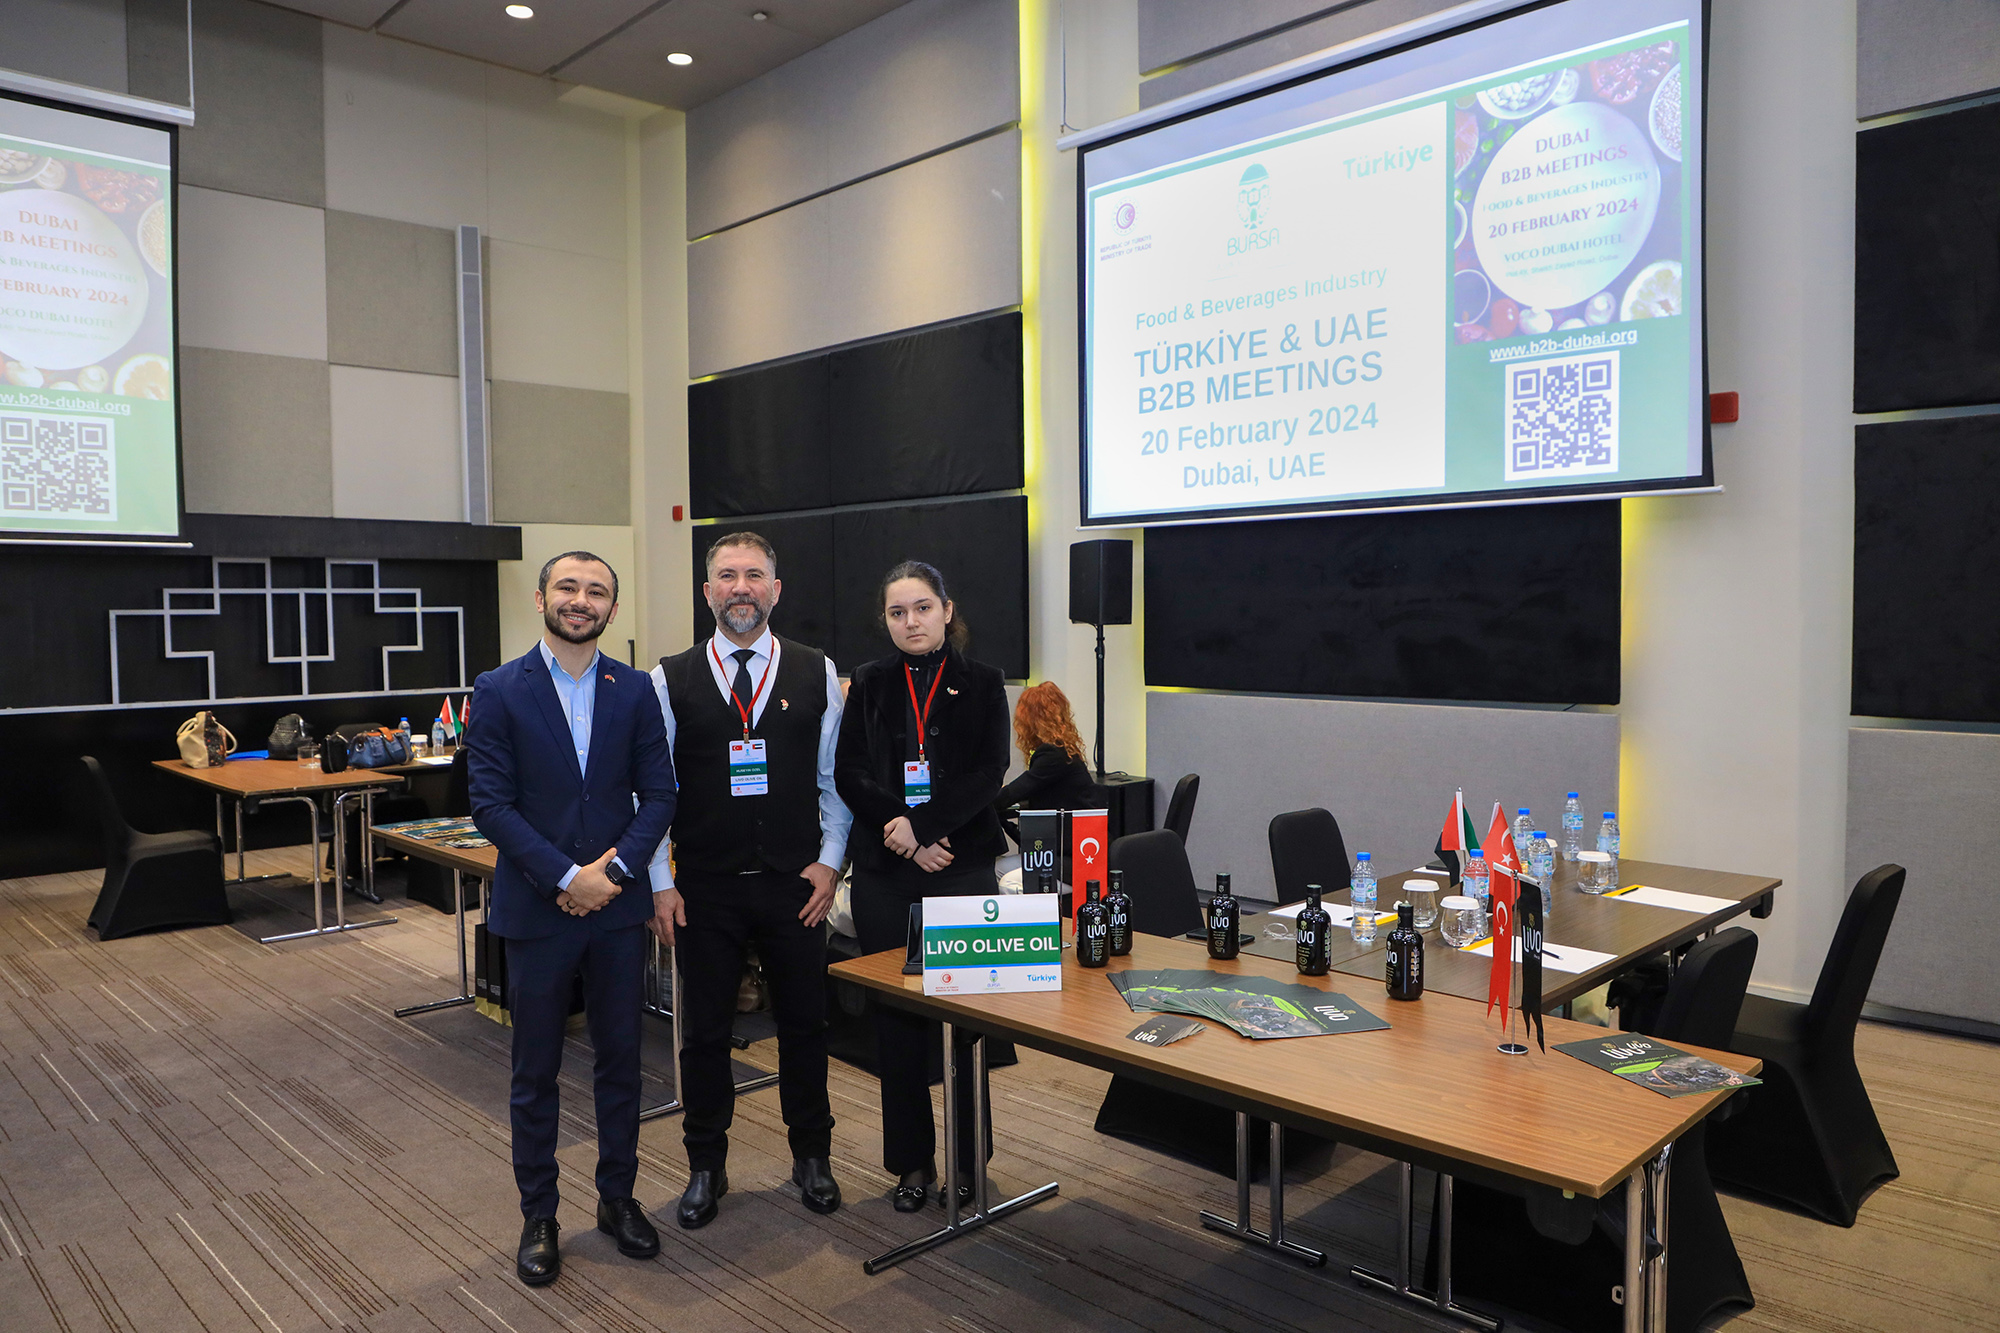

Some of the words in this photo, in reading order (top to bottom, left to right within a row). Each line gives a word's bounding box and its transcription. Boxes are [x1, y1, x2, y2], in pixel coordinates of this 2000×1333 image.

[1535, 128, 1591, 154] DUBAI
[1343, 144, 1434, 181] Türkiye
[1501, 163, 1532, 185] B2B
[1535, 145, 1629, 178] MEETINGS
[1515, 196, 1525, 206] &
[1526, 183, 1588, 204] BEVERAGES
[1590, 171, 1650, 190] INDUSTRY
[19, 210, 79, 232] DUBAI
[1488, 223, 1508, 239] 20
[1511, 206, 1592, 235] FEBRUARY
[1595, 197, 1639, 218] 2024
[20, 233, 119, 259] MEETINGS
[1227, 228, 1280, 256] BURSA
[1504, 248, 1540, 263] VOCO
[1542, 241, 1580, 257] DUBAI
[1583, 233, 1625, 249] HOTEL
[10, 257, 79, 275] BEVERAGES
[86, 288, 129, 306] 2024
[1136, 305, 1178, 331] Food
[1182, 303, 1195, 321] &
[1201, 285, 1298, 317] Beverages
[1304, 267, 1388, 297] Industry
[30, 310, 71, 323] DUBAI
[74, 315, 114, 328] HOTEL
[1134, 329, 1269, 378] TÜRKİYE
[1279, 323, 1302, 353] &
[1314, 307, 1388, 348] UAE
[1490, 329, 1638, 361] www.b2b-dubai.org
[1138, 380, 1196, 414] B2B
[1206, 351, 1383, 404] MEETINGS
[1141, 428, 1169, 456] 20
[1178, 416, 1299, 452] February
[1308, 402, 1379, 436] 2024
[1183, 459, 1260, 489] Dubai,
[1268, 452, 1326, 481] UAE
[983, 898, 999, 923] 9
[926, 939, 968, 955] LIVO
[972, 938, 1025, 953] OLIVE
[1029, 936, 1059, 952] OIL
[1026, 974, 1057, 983] Türkiye
